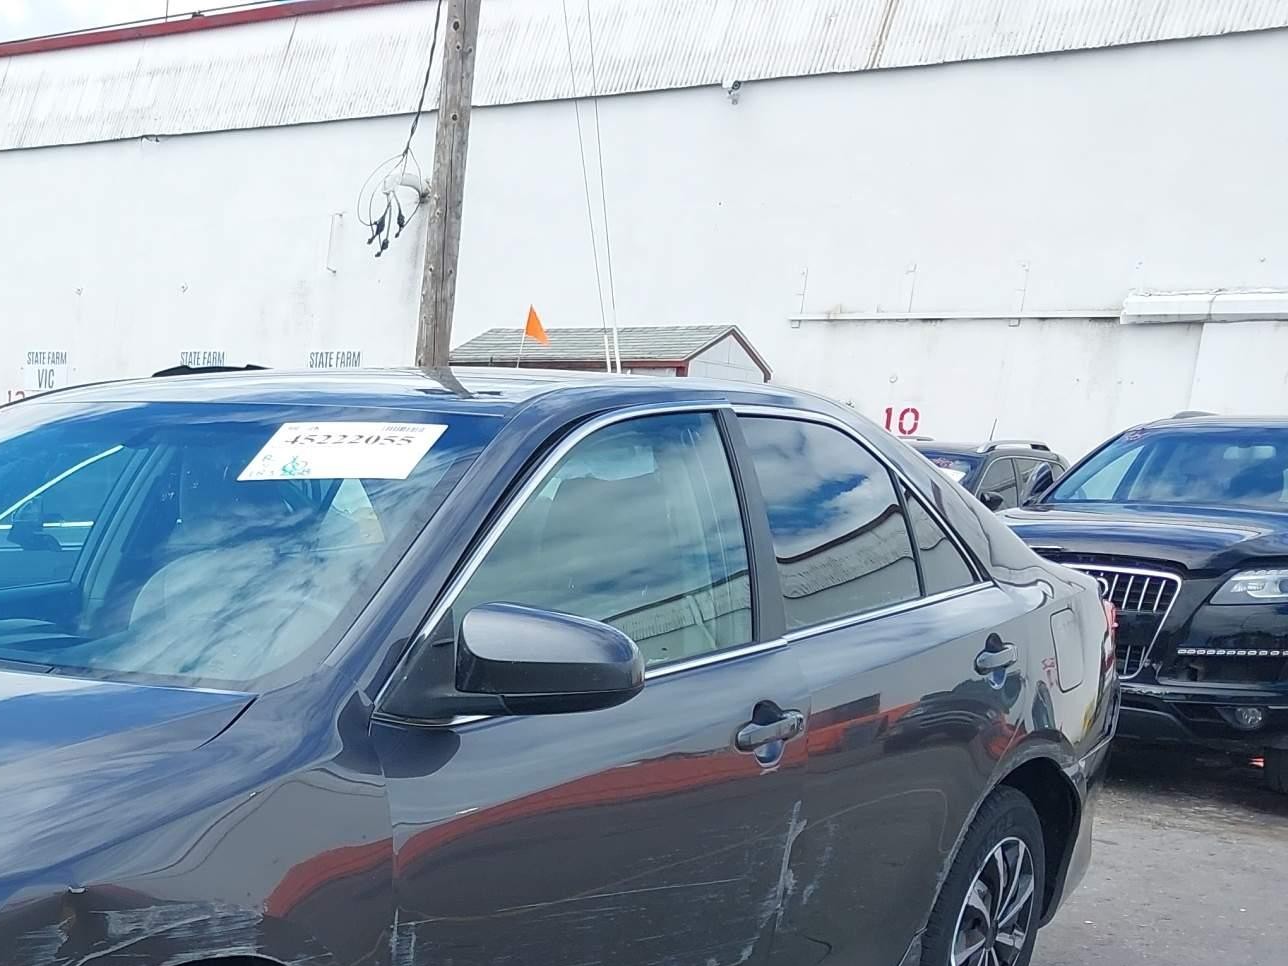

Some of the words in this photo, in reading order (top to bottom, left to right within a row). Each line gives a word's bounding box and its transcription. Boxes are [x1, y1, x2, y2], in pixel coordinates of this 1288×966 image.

[27, 352, 46, 365] STATE
[47, 352, 67, 365] FARM
[180, 352, 201, 366] STATE
[202, 352, 225, 366] FARM
[309, 352, 333, 368] STATE
[335, 352, 361, 368] FARM
[37, 368, 55, 389] VIC
[884, 407, 920, 435] 10
[284, 434, 416, 447] 45222055
